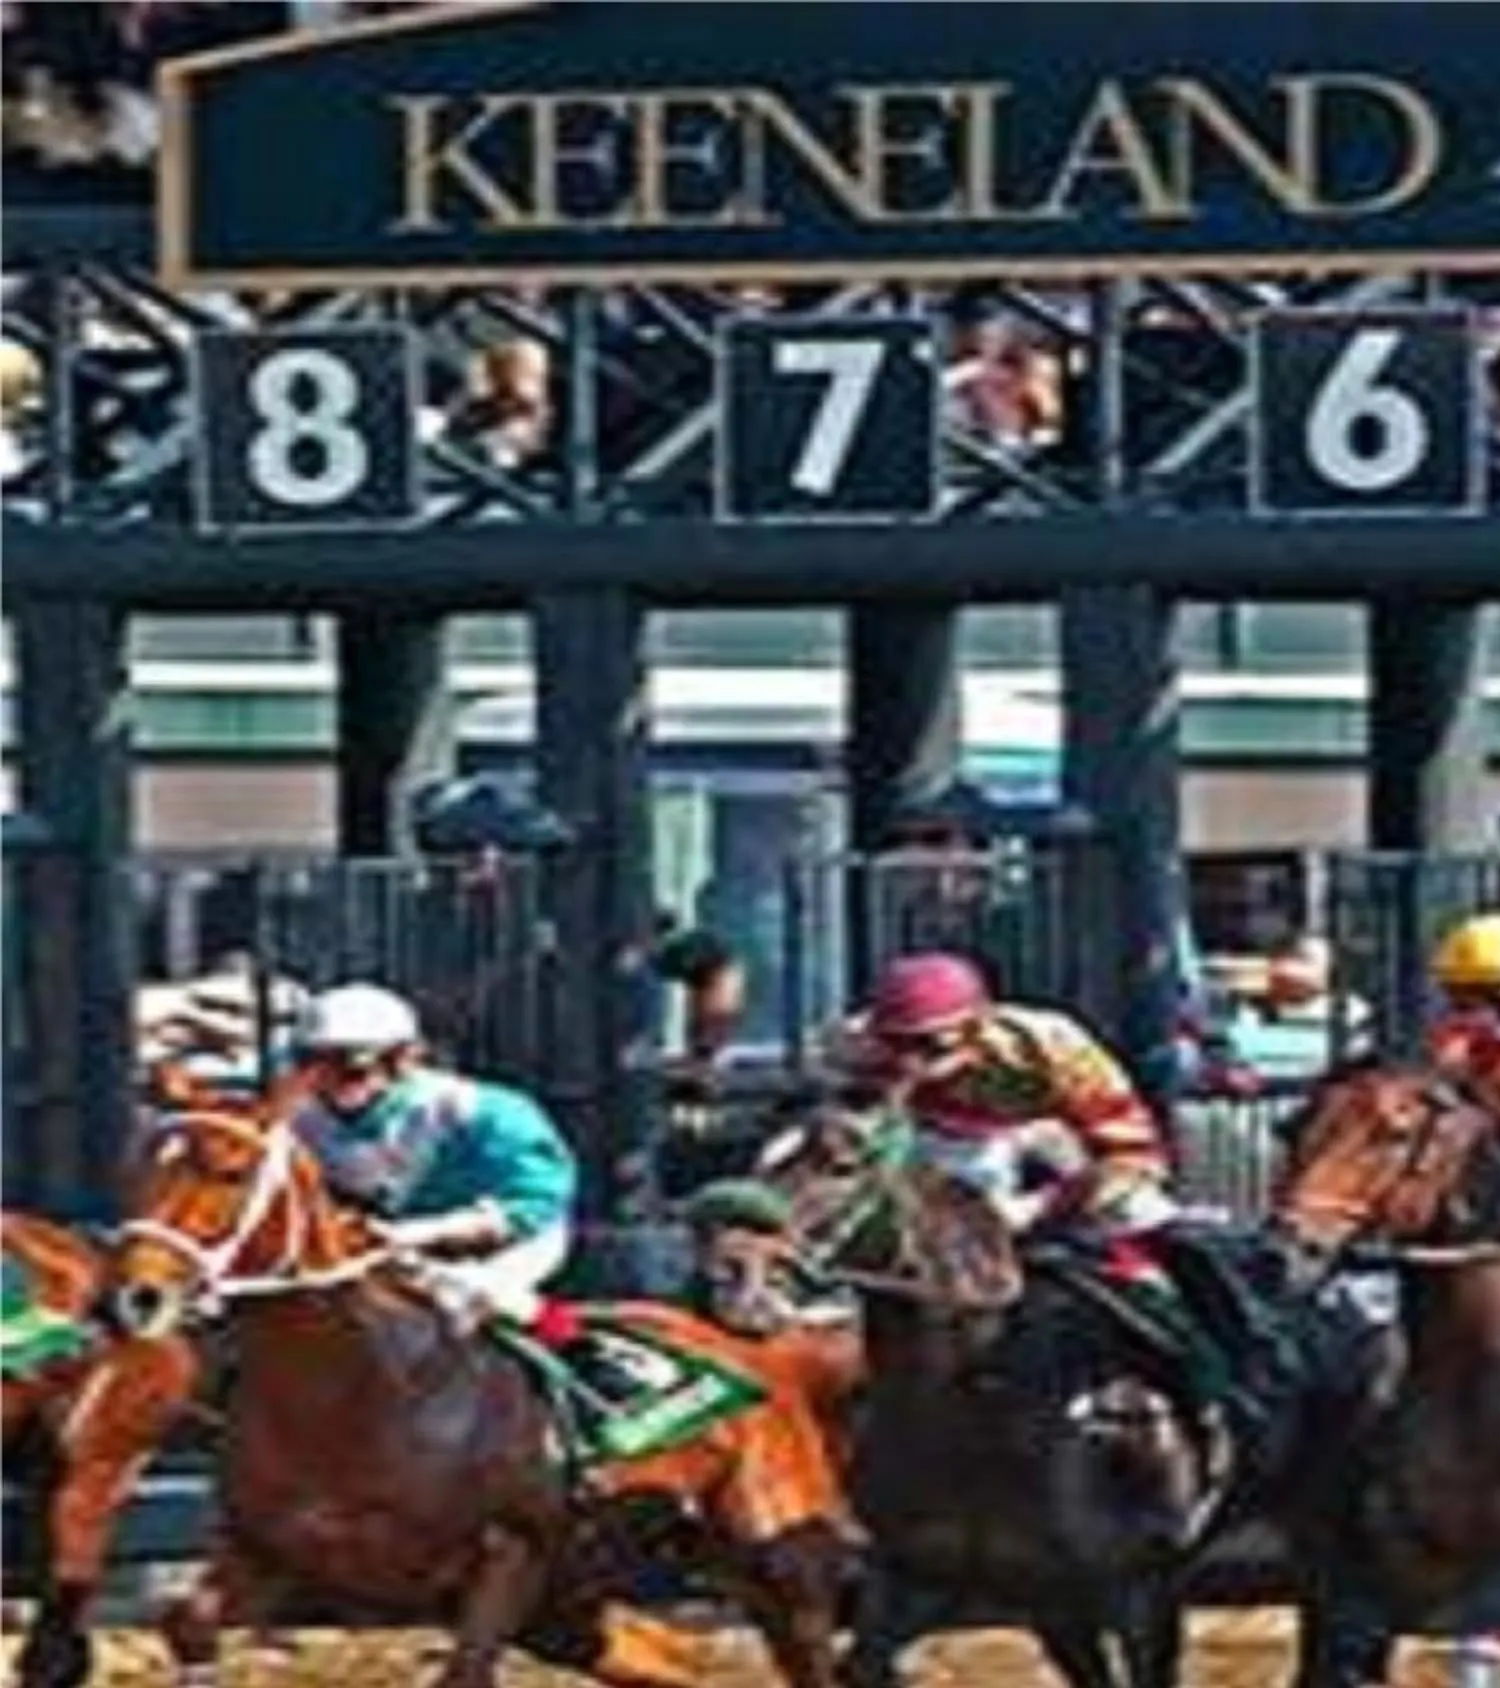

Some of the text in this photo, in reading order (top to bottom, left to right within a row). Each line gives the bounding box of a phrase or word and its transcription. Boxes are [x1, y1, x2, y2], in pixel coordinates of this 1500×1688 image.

[390, 76, 1442, 234] KEENELAND
[248, 348, 369, 507] 8
[774, 339, 888, 497] 7
[1306, 329, 1429, 490] 6
